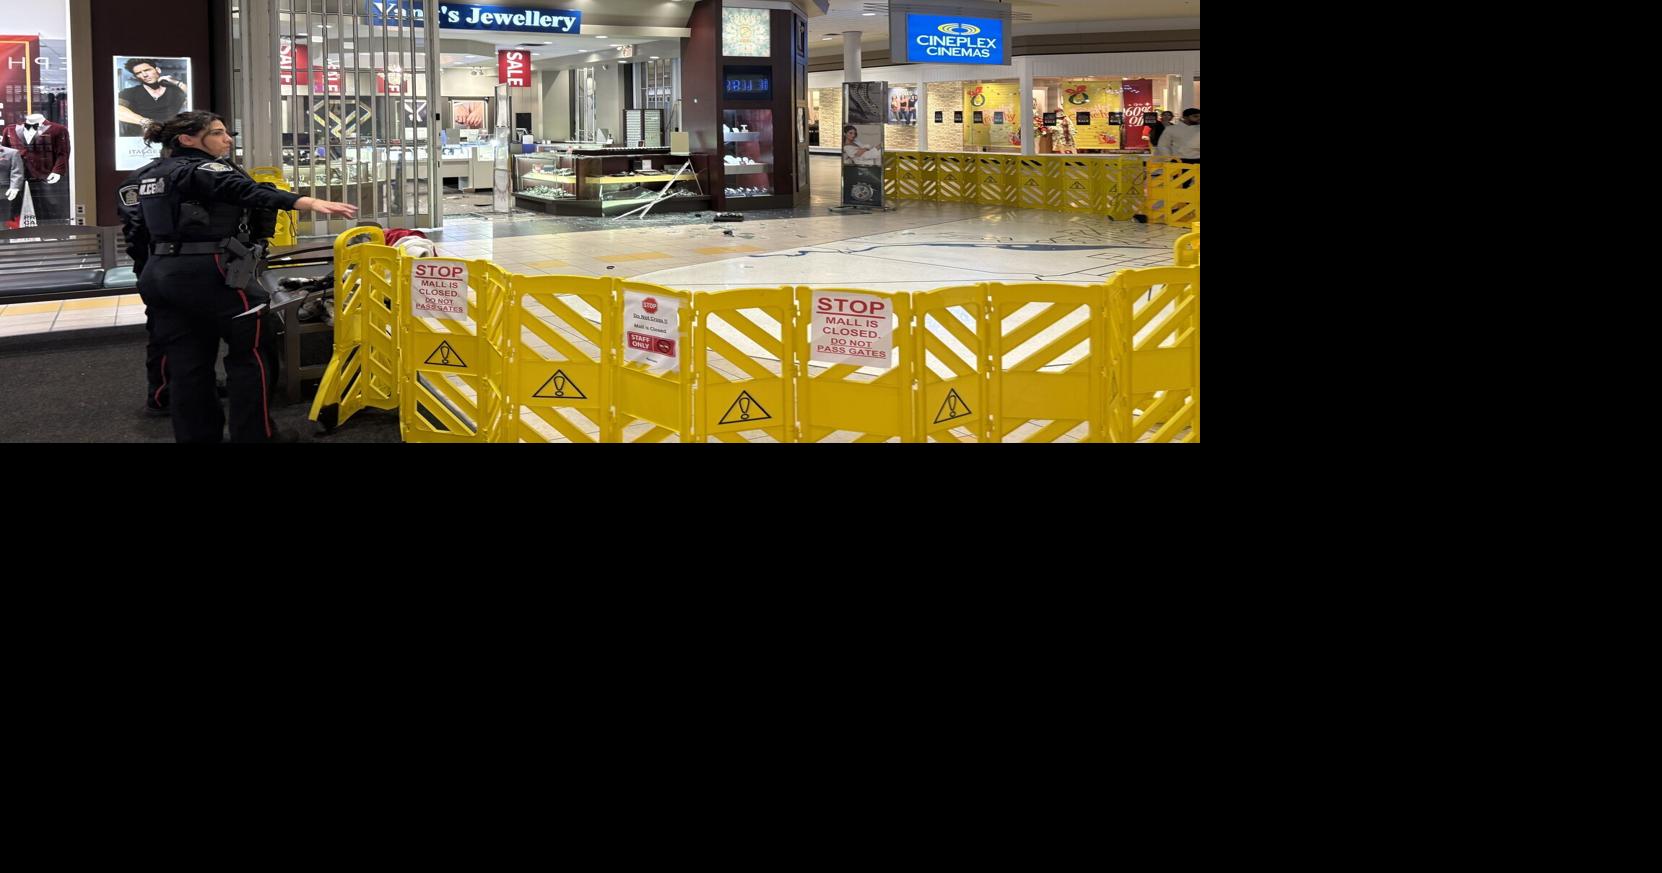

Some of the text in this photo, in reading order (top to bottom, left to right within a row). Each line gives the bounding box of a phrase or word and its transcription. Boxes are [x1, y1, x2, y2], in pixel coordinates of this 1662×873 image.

[466, 7, 577, 32] Jewellery
[916, 34, 997, 49] CINEPLEX
[926, 46, 990, 58] CINEMAS
[506, 52, 523, 86] SALE
[415, 264, 463, 277] STOP
[421, 280, 447, 288] MALL
[817, 297, 885, 314] STOP
[825, 316, 879, 328] MALL IS
[631, 334, 650, 343] STAFF
[822, 326, 881, 339] CLOSED.
[632, 341, 650, 349] ONLY
[849, 340, 872, 348] NOT
[817, 345, 886, 358] PASS GATES
